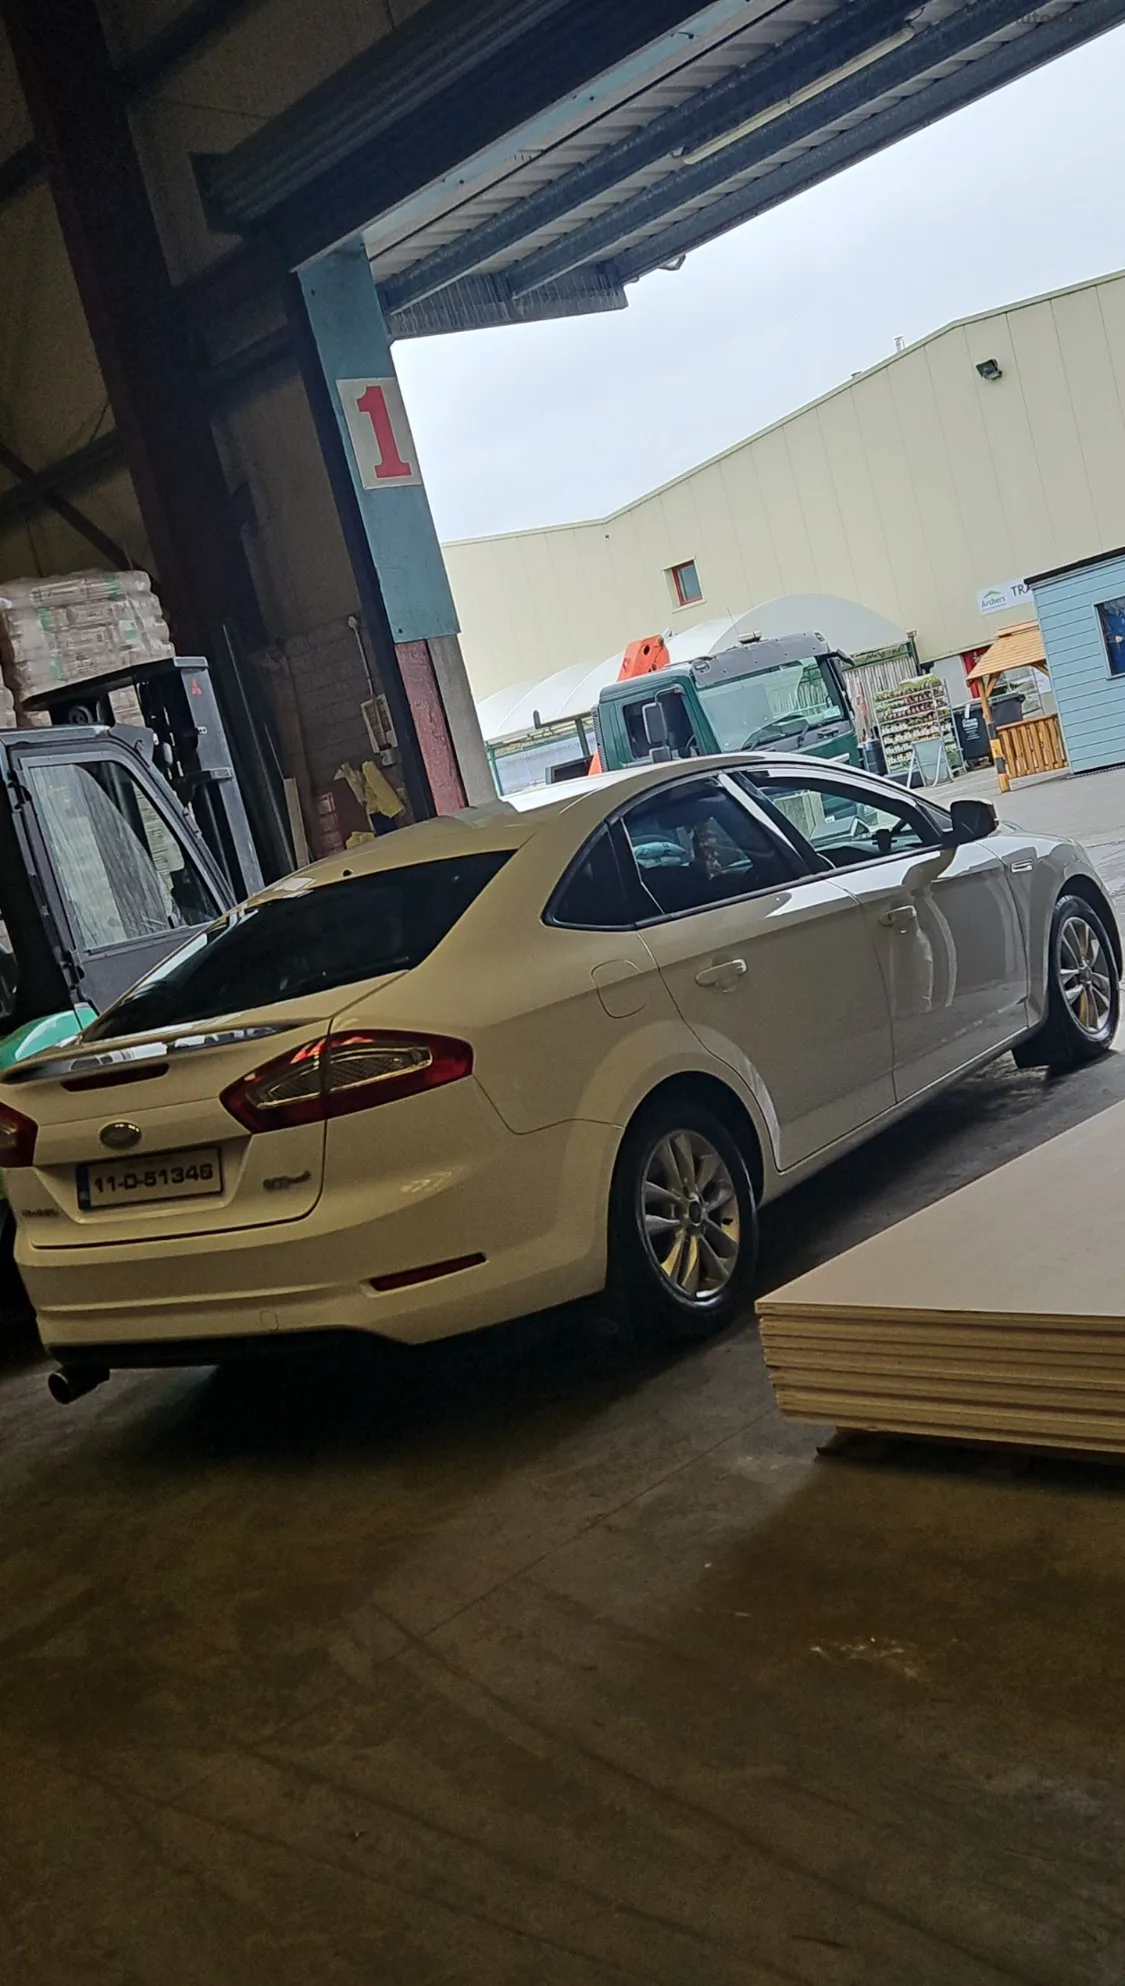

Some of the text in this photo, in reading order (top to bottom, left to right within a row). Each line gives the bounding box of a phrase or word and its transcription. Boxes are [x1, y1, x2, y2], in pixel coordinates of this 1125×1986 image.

[356, 385, 412, 479] 1
[981, 595, 1006, 609] Archers
[94, 1163, 213, 1193] 11-D-51346
